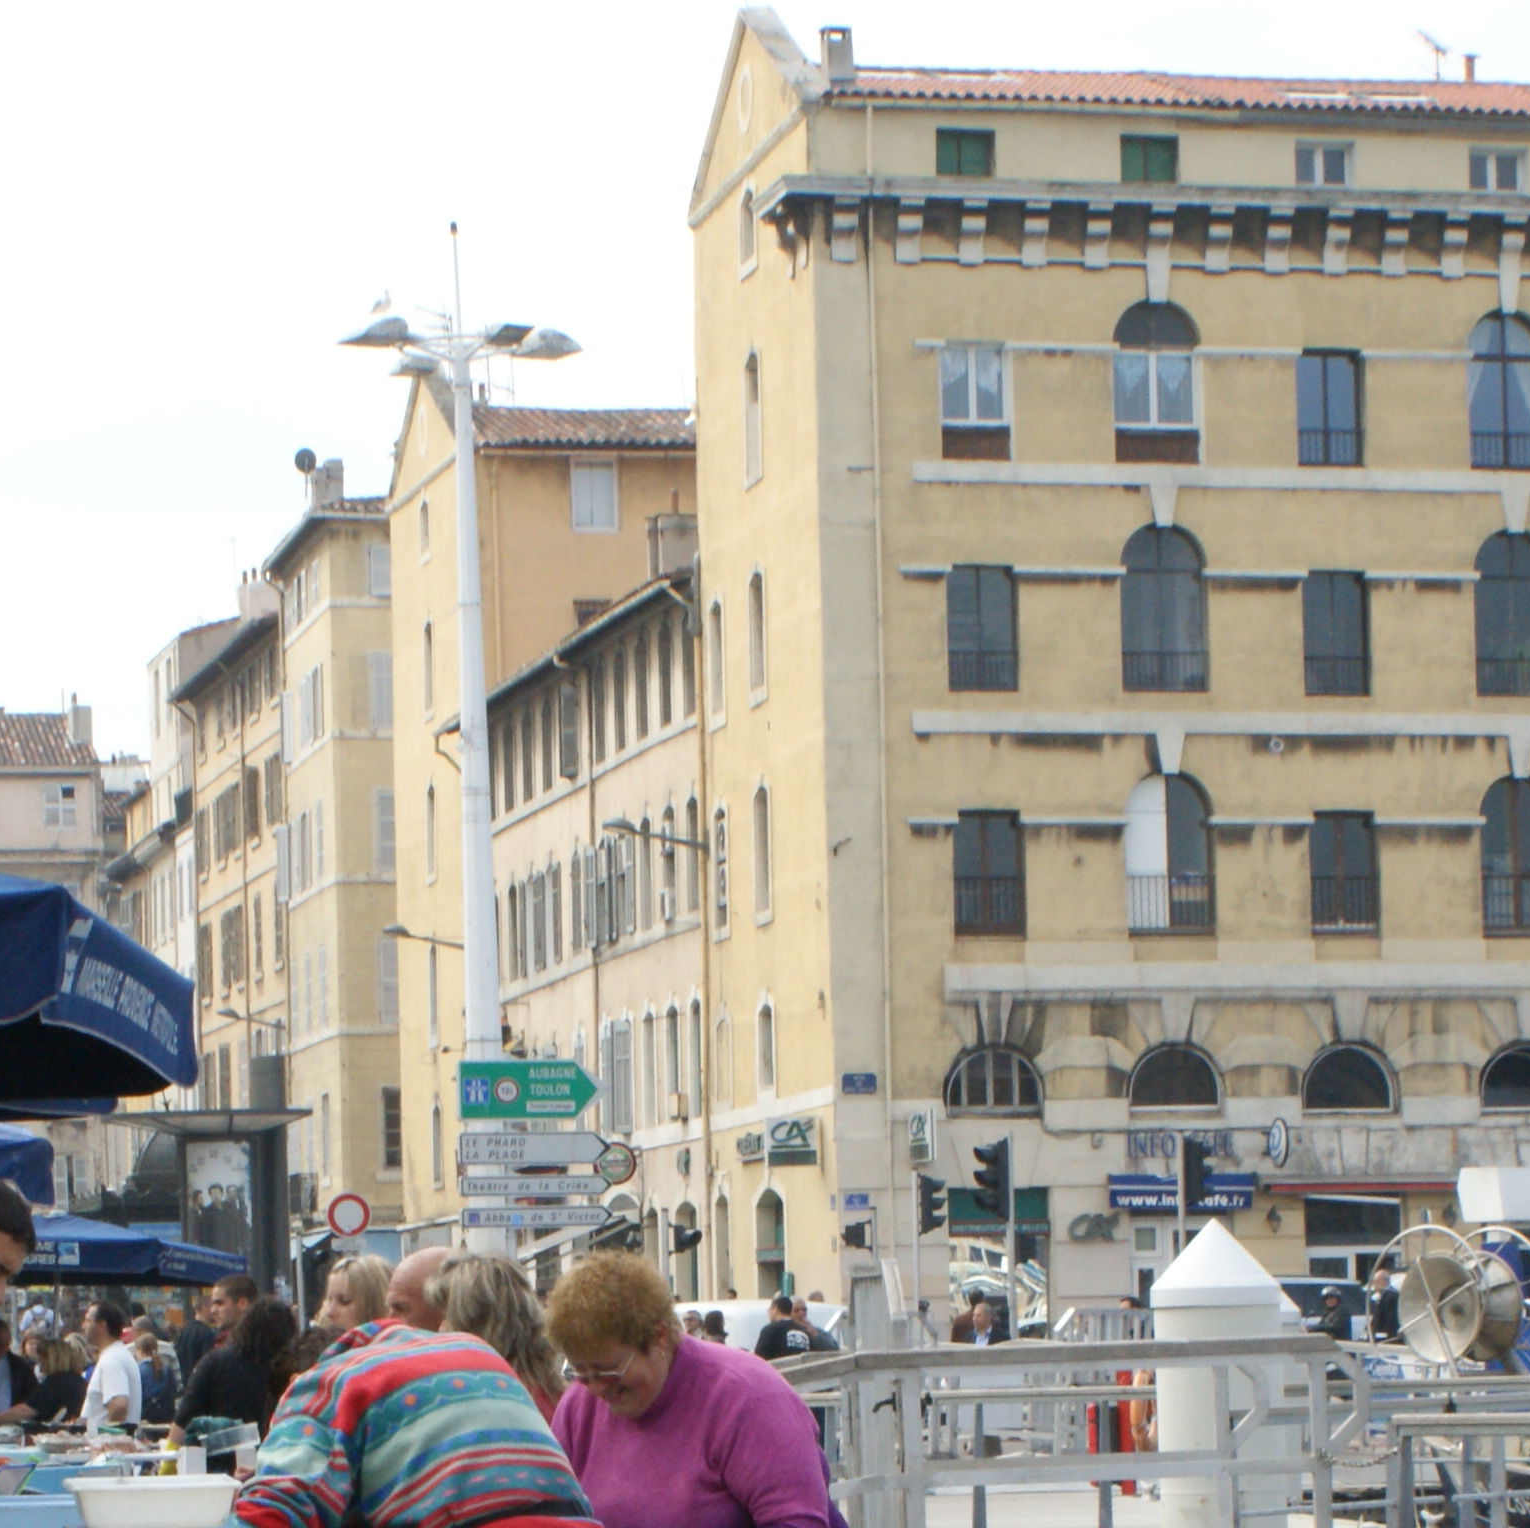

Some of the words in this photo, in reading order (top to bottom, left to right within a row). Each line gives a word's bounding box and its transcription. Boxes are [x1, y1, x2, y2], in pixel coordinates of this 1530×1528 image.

[529, 1067, 577, 1080] AUBAGNE
[529, 1084, 571, 1097] TOULON
[771, 1117, 814, 1145] CA
[465, 1138, 478, 1147] LE
[487, 1137, 526, 1147] PHARO
[1127, 1131, 1176, 1158] INFO
[465, 1151, 479, 1160] LA
[488, 1150, 525, 1160] PLAGE
[519, 1181, 531, 1191] de
[539, 1181, 550, 1190] la
[484, 1213, 524, 1222] Abba
[531, 1212, 543, 1221] de
[569, 1210, 601, 1221] Victor
